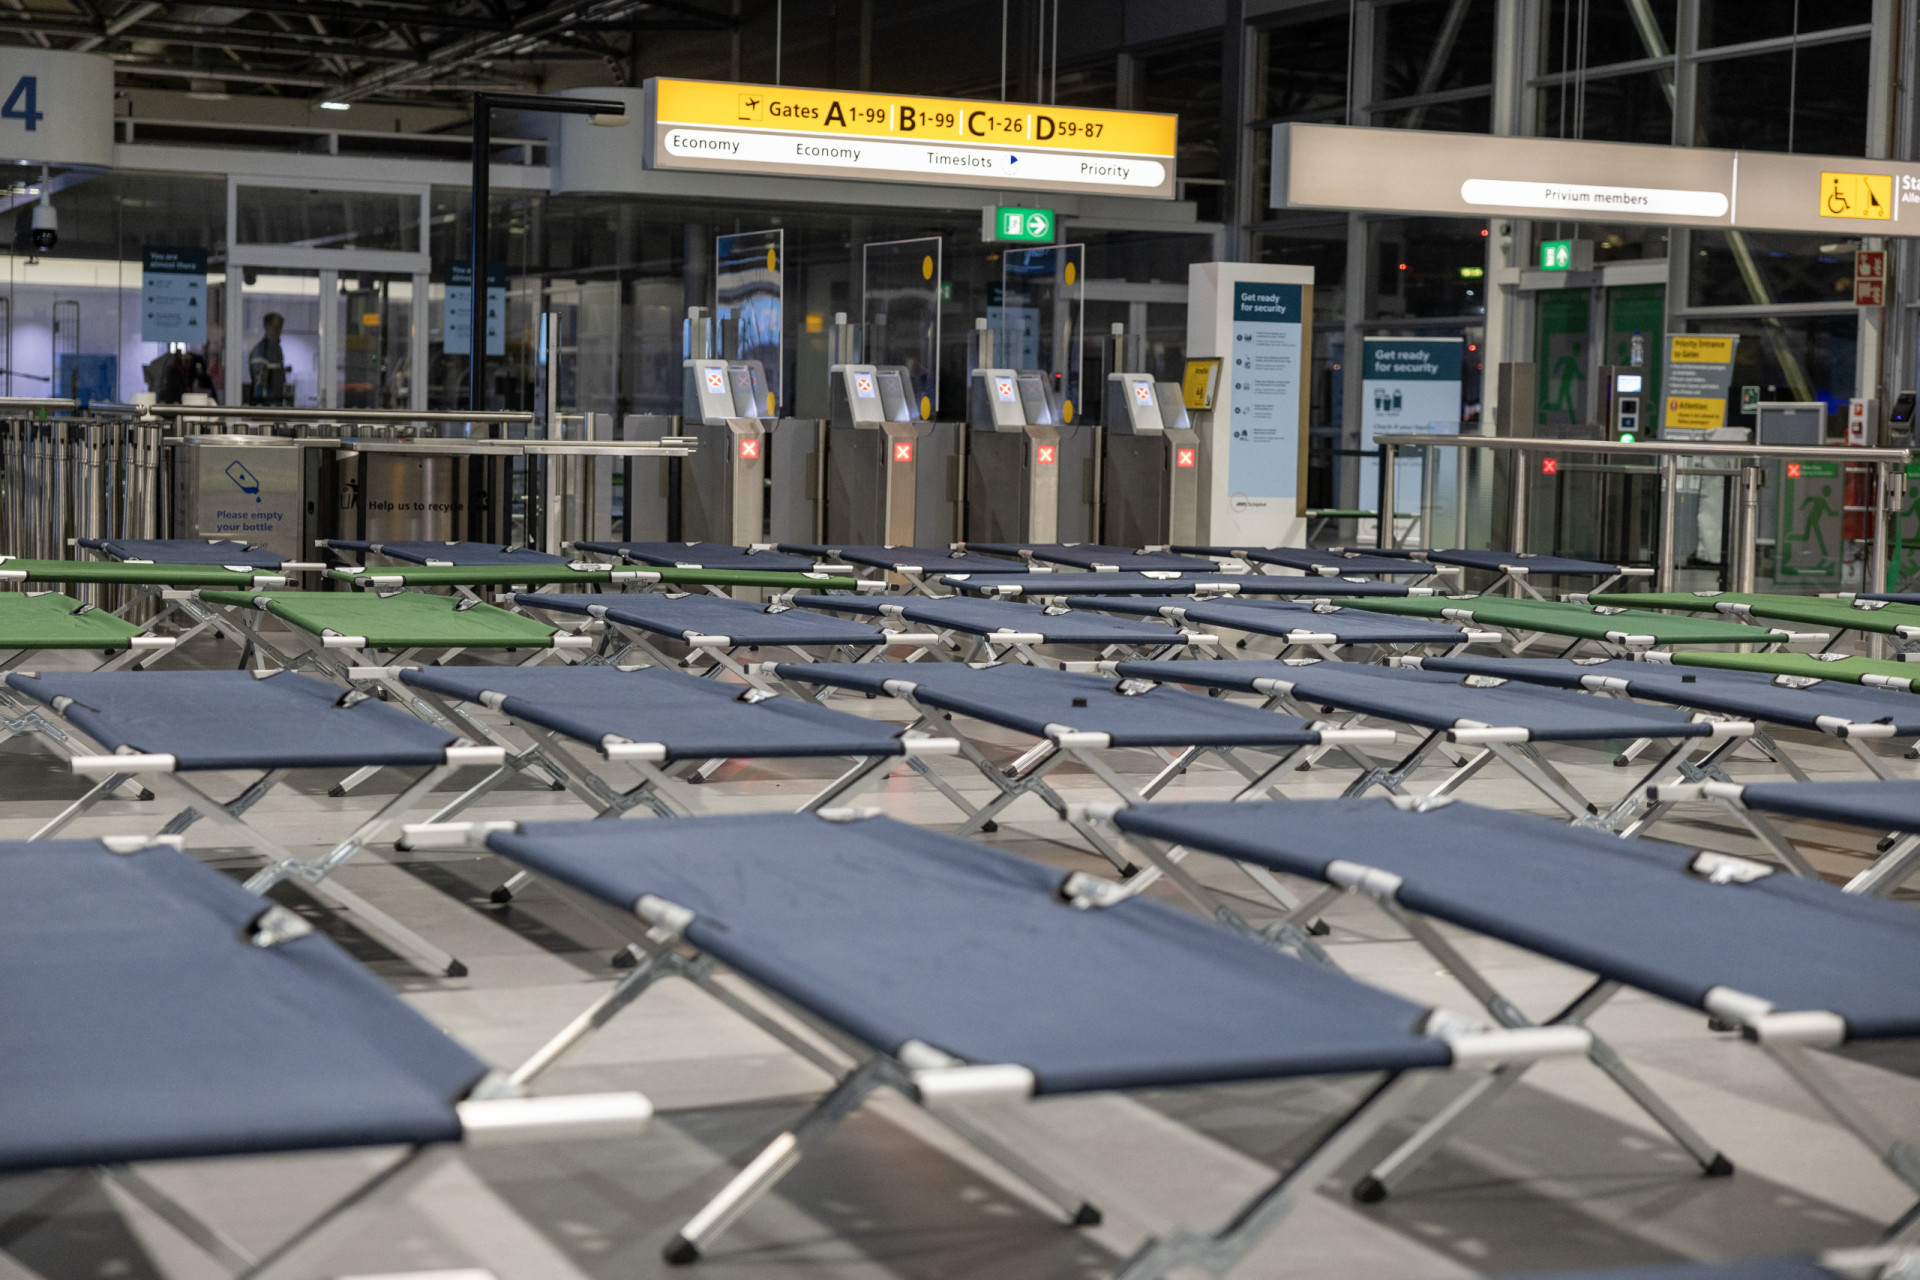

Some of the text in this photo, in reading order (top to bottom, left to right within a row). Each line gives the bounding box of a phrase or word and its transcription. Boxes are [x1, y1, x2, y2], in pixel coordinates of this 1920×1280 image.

[1, 75, 43, 132] 4
[769, 101, 1104, 140] Gates A 1-99 B 1-99 C 1-26 D 59-87
[673, 135, 1130, 180] Economy Economy Timeslots Priority
[1545, 189, 1648, 205] Privium members
[1241, 292, 1280, 304] Get ready
[1241, 302, 1287, 315] for security
[1374, 349, 1430, 363] Get ready
[1374, 361, 1439, 375] for security
[368, 501, 395, 513] Help
[398, 502, 411, 511] us
[413, 502, 425, 511] to
[216, 510, 283, 524] Please empty
[216, 521, 273, 533] your bottle
